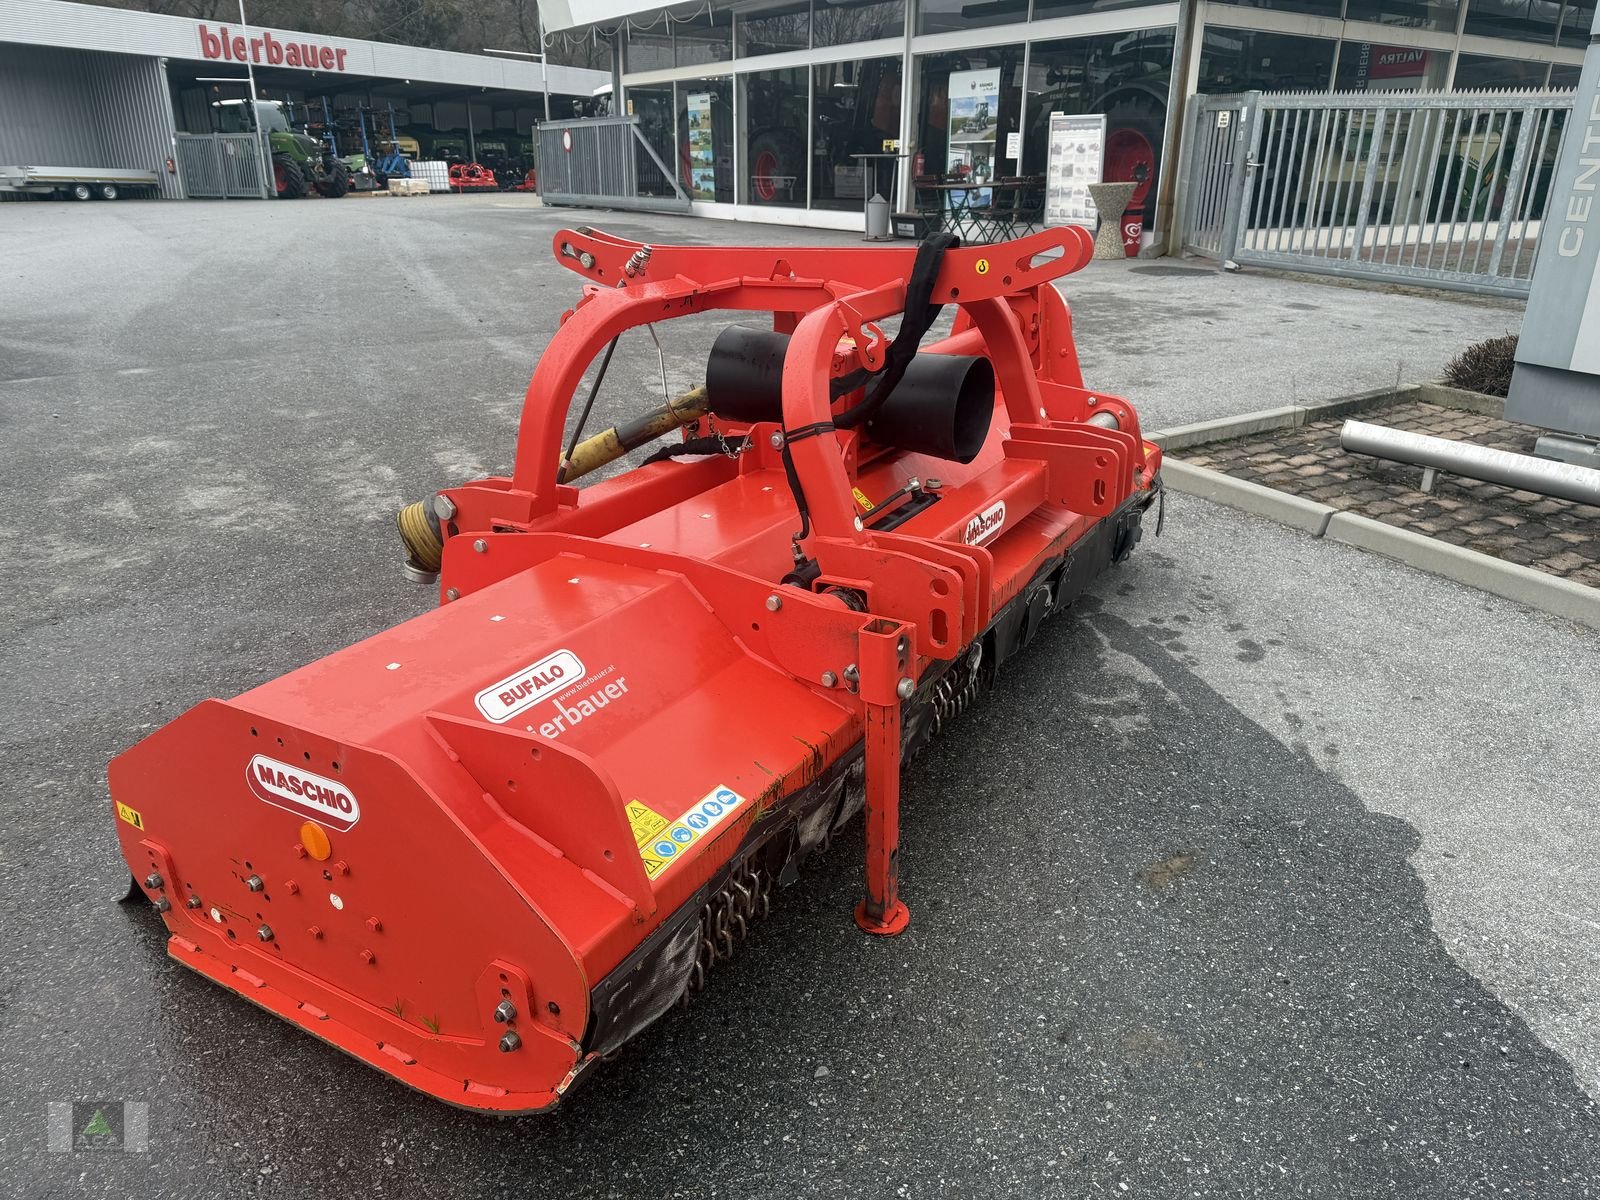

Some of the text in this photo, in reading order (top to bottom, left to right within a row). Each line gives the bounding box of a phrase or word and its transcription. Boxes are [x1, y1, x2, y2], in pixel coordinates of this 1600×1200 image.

[199, 24, 347, 71] bierbauer
[1558, 78, 1600, 257] CENT
[967, 507, 1003, 543] MASCHIO
[498, 665, 564, 707] BUFALO
[558, 664, 616, 701] www.bierbauer.at
[526, 676, 629, 739] erbauer
[257, 763, 353, 814] MASCHIO
